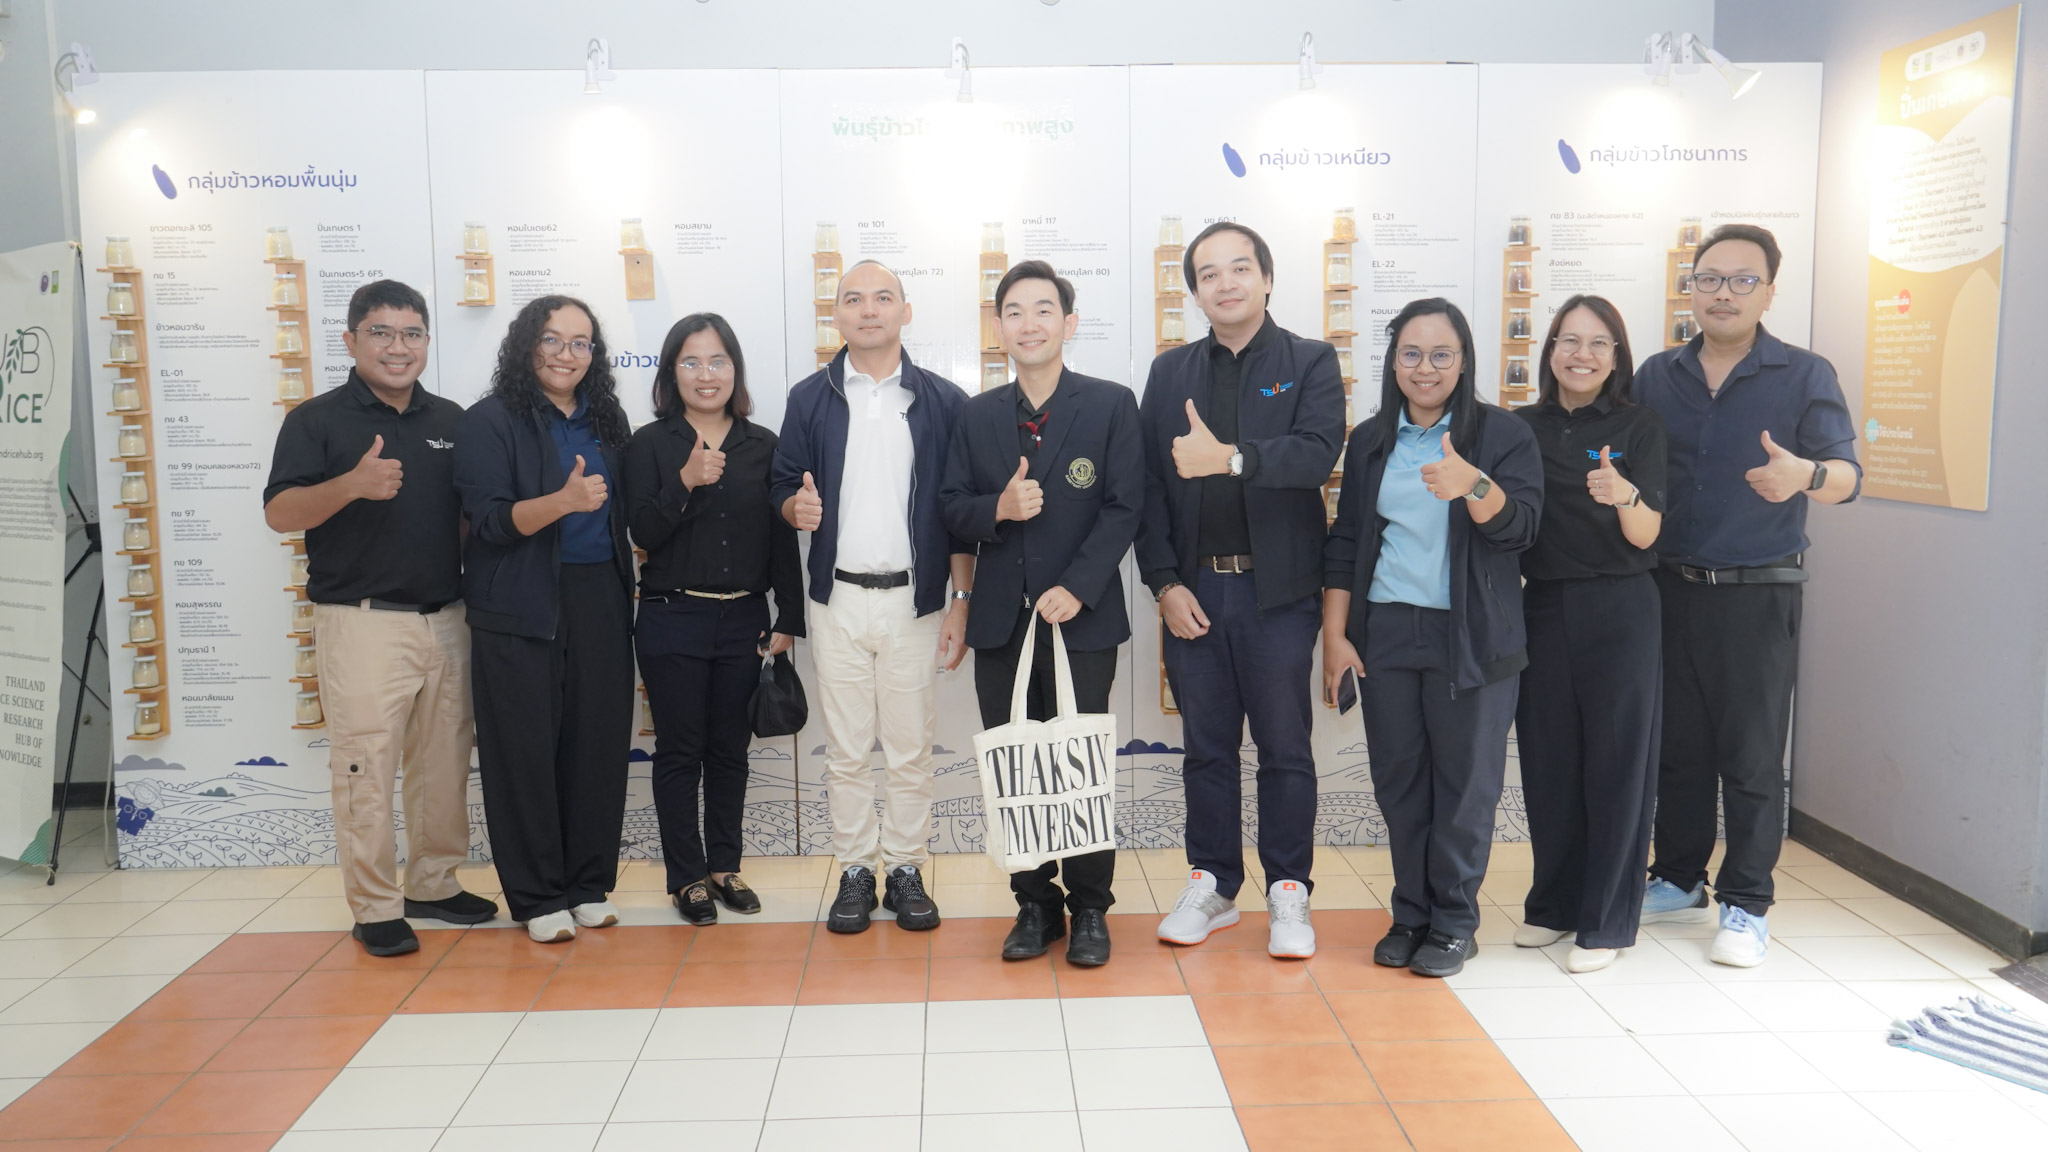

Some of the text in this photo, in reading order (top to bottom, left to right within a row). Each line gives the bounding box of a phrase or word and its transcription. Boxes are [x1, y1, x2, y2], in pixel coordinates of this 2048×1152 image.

[1259, 147, 1392, 170] กลุ่มข้าวเหนียว
[1590, 145, 1748, 167] กลุ่มข้าวโภชนาการ
[188, 164, 358, 194] กลุ่มข้าวหอมพื้นนุ่ม
[872, 220, 885, 228] 101
[1045, 217, 1057, 225] 117
[198, 223, 213, 232] 105
[1372, 260, 1395, 268] EL-22
[166, 271, 176, 280] 15
[509, 268, 551, 276] หอมสยาม2
[160, 369, 184, 377] EL-01
[178, 415, 189, 423] 43
[181, 462, 193, 470] 99
[184, 509, 195, 517] 97
[187, 558, 203, 567] 109
[175, 601, 222, 610] หอมสุพรรณ
[5, 675, 46, 692] THAILAND
[181, 693, 234, 702] หอมมาลัยแมน
[12, 695, 45, 712] SCIENCE
[4, 712, 43, 730] RESEARCH
[16, 733, 44, 749] HUB OF
